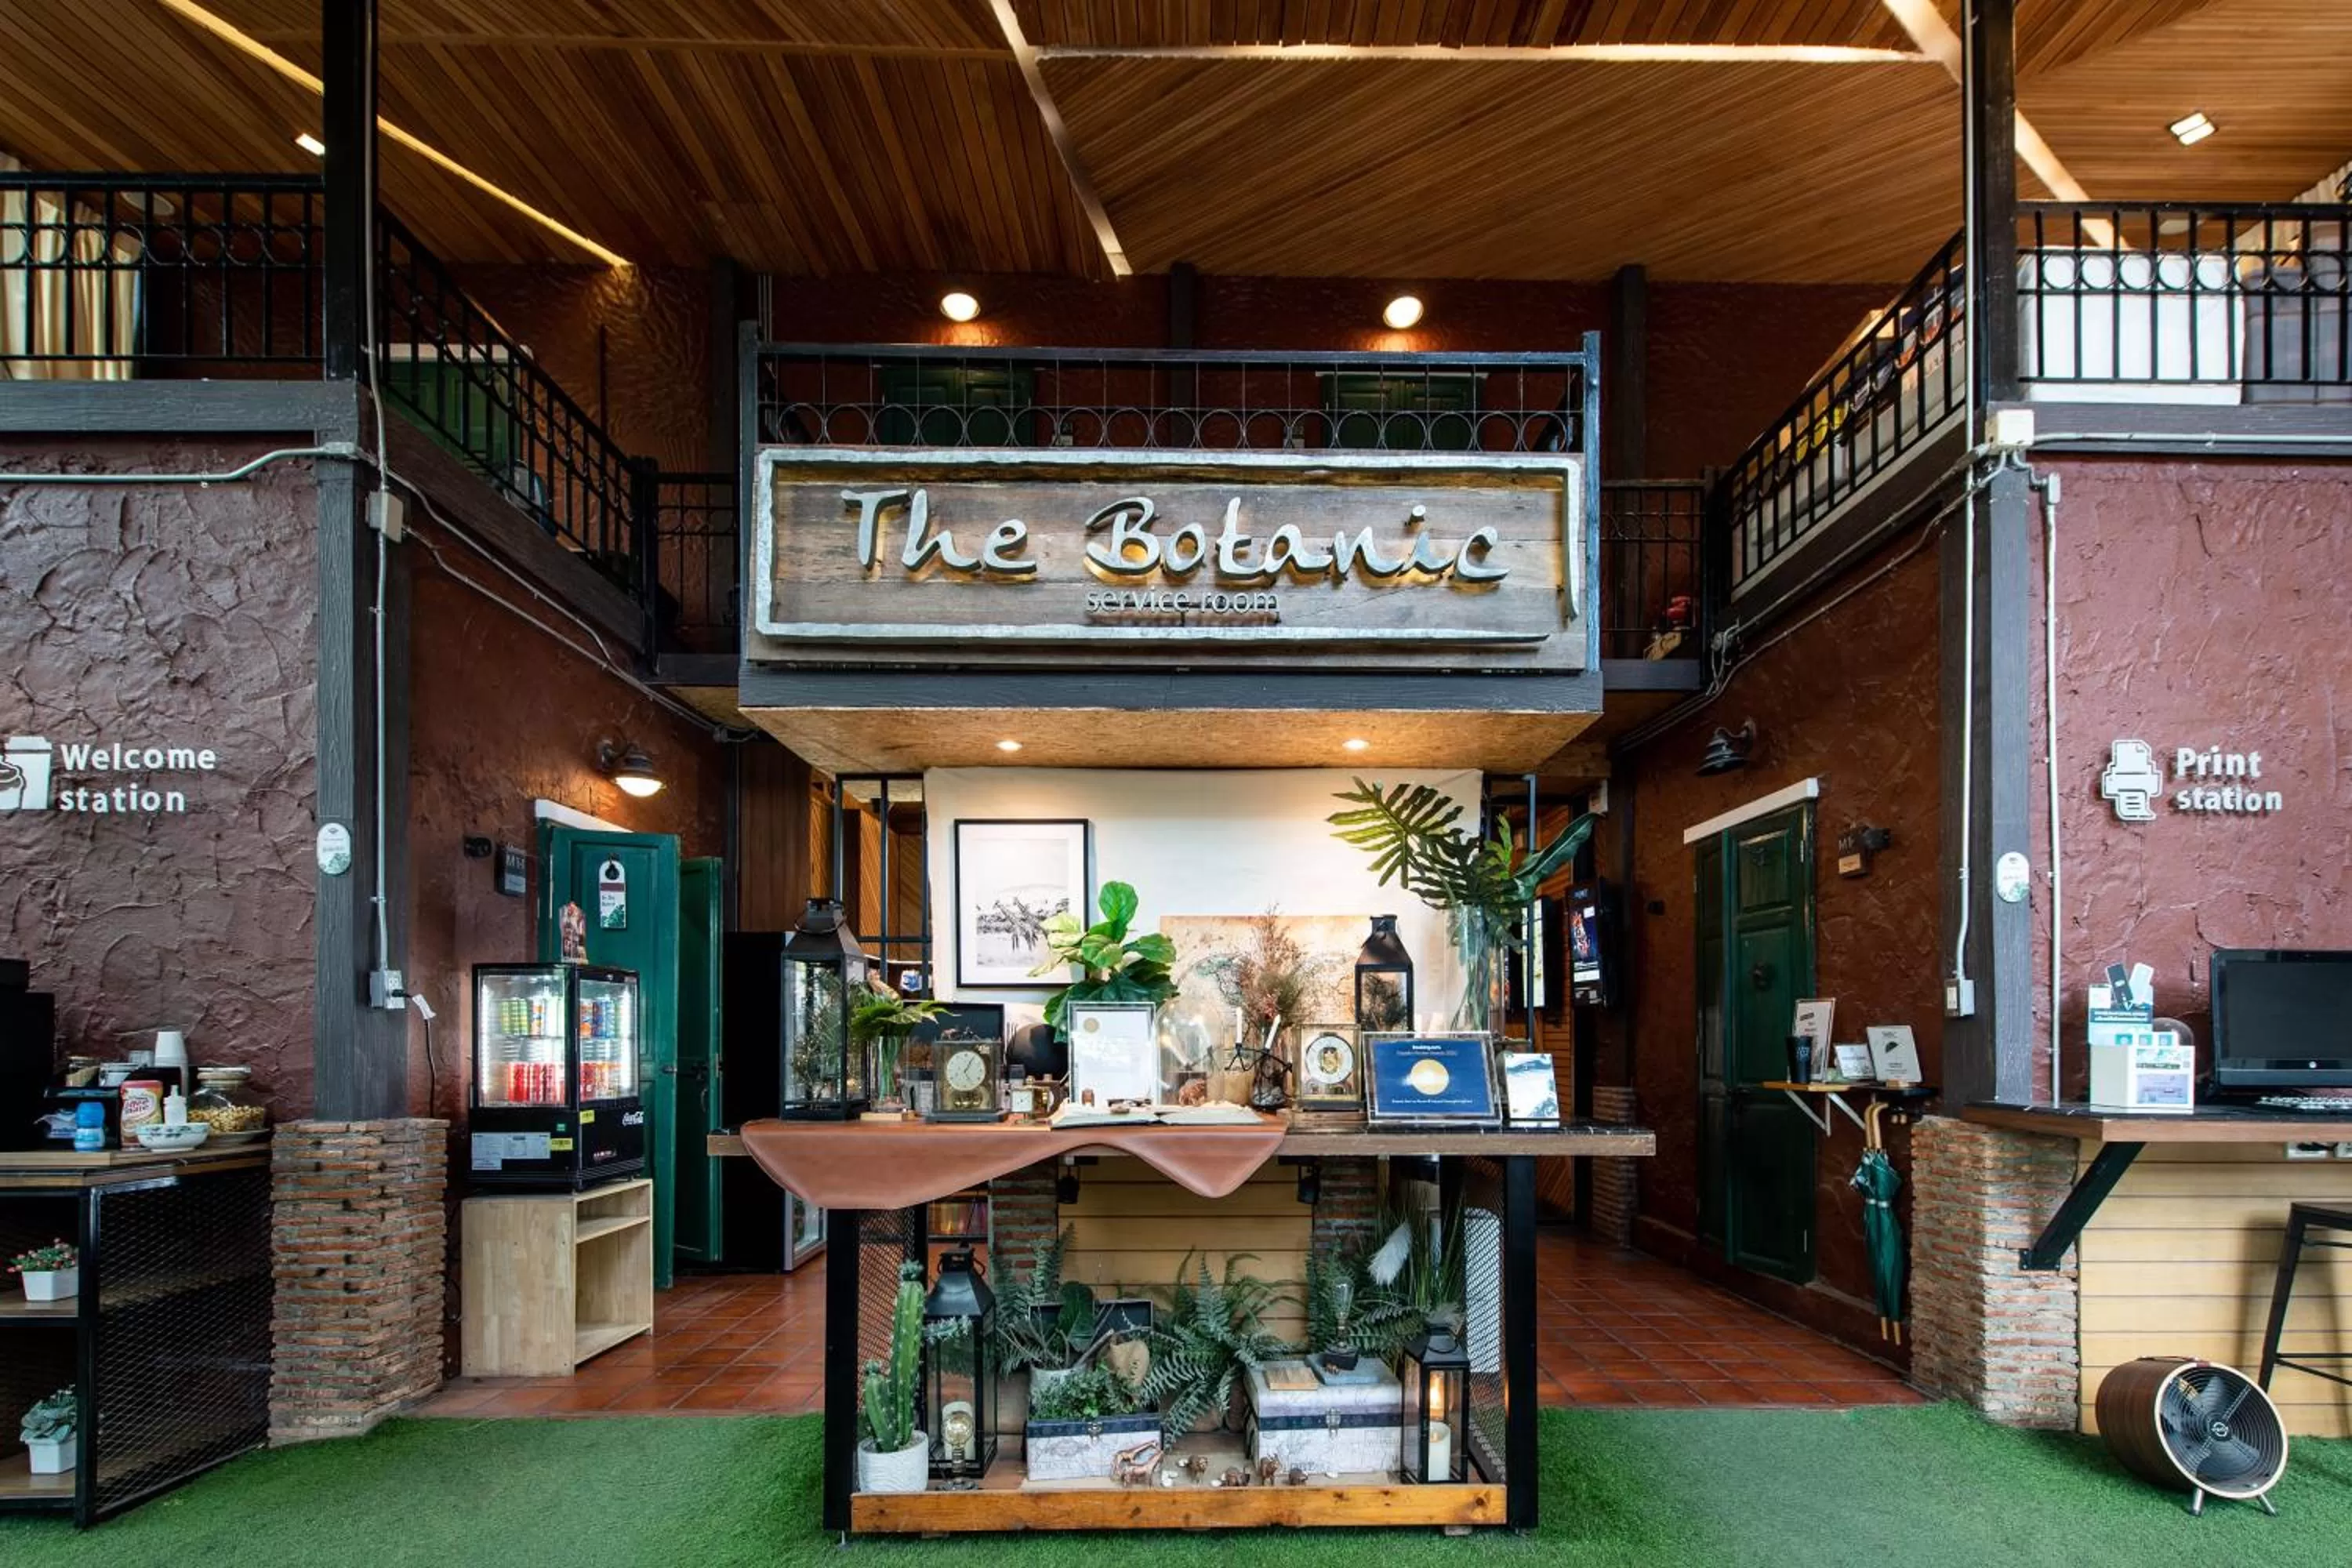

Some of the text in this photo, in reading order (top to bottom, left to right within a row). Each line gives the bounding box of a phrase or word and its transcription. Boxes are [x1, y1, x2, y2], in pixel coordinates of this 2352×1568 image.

[840, 488, 1512, 582] The Botanic
[1085, 586, 1281, 614] service room
[60, 742, 216, 771] Welcome
[2176, 745, 2262, 779] Print
[60, 782, 186, 812] station
[2176, 786, 2283, 812] station
